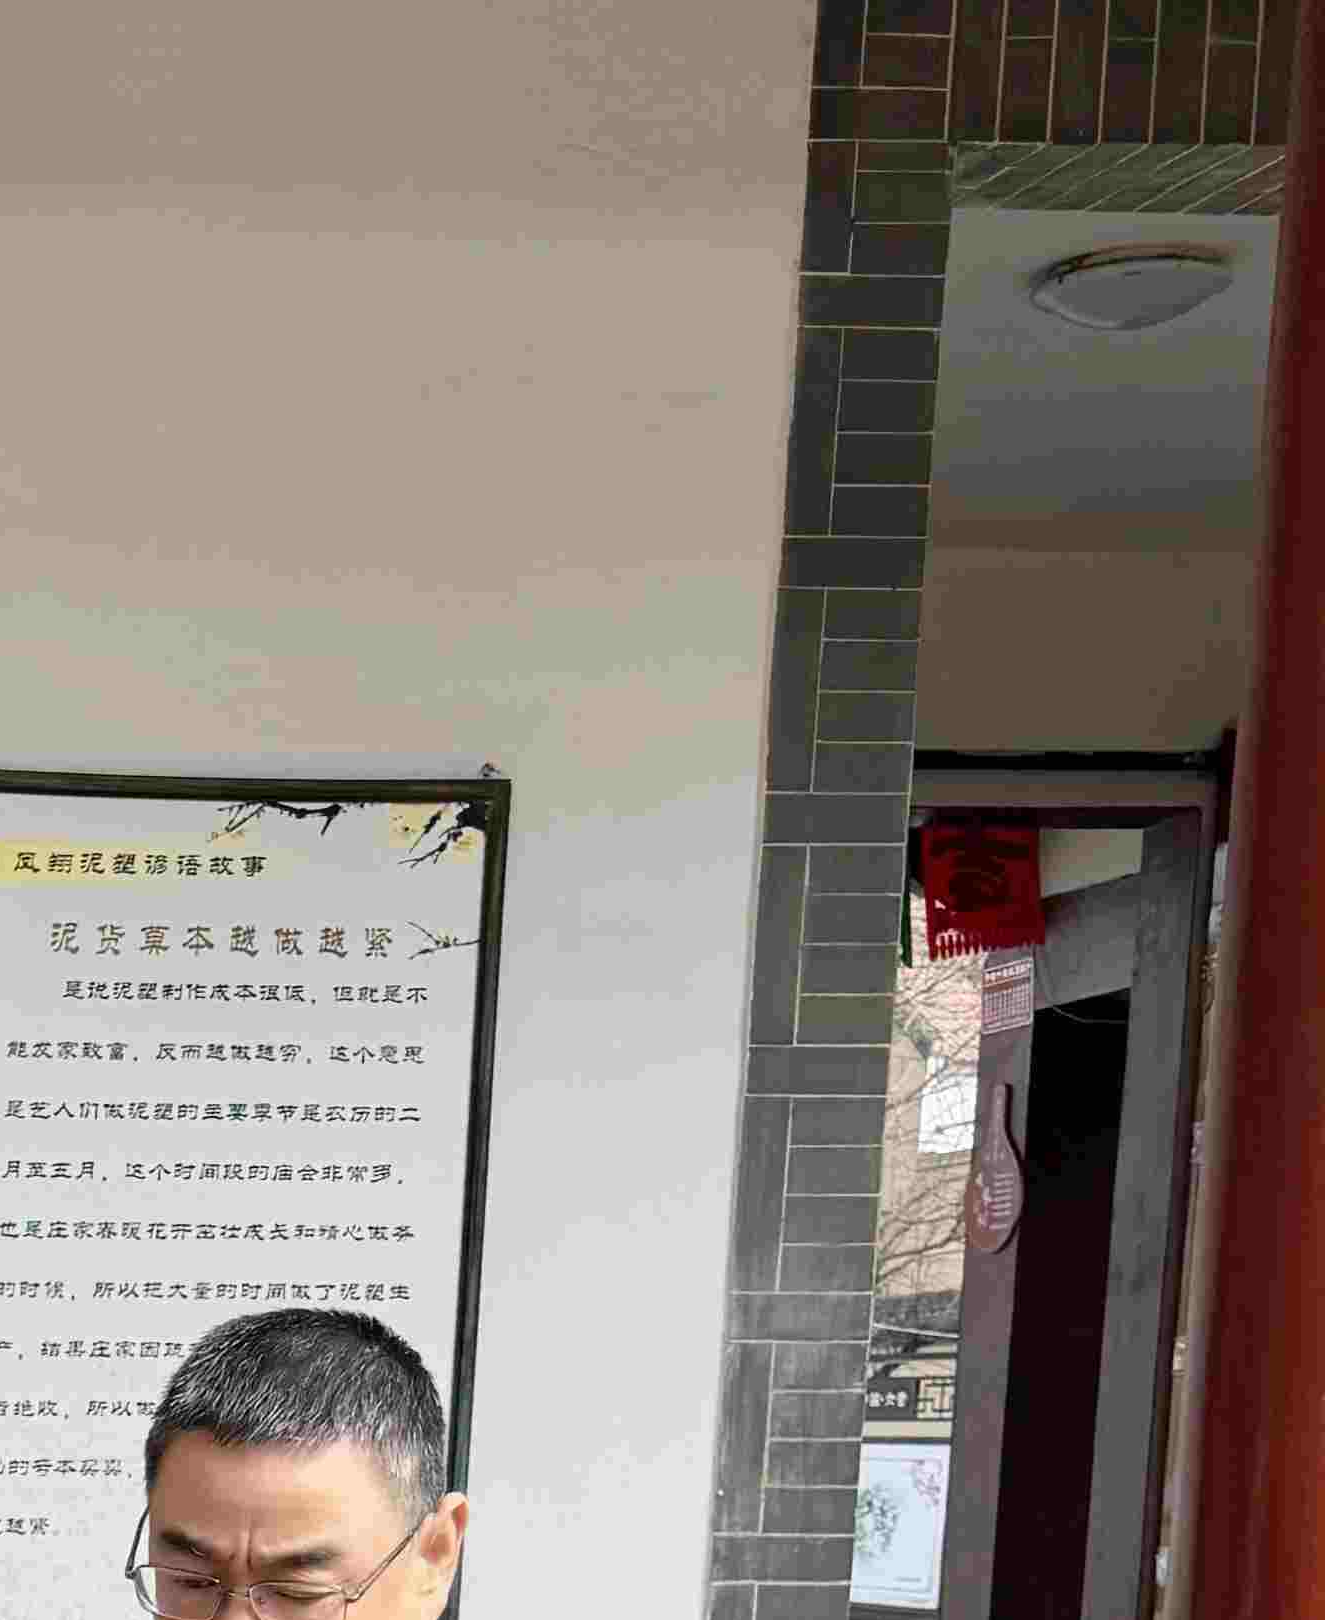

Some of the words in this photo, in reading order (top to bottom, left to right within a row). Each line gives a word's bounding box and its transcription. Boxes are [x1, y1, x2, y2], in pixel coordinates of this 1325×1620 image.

[13, 851, 268, 878] 凤翔泥塑谚语故事
